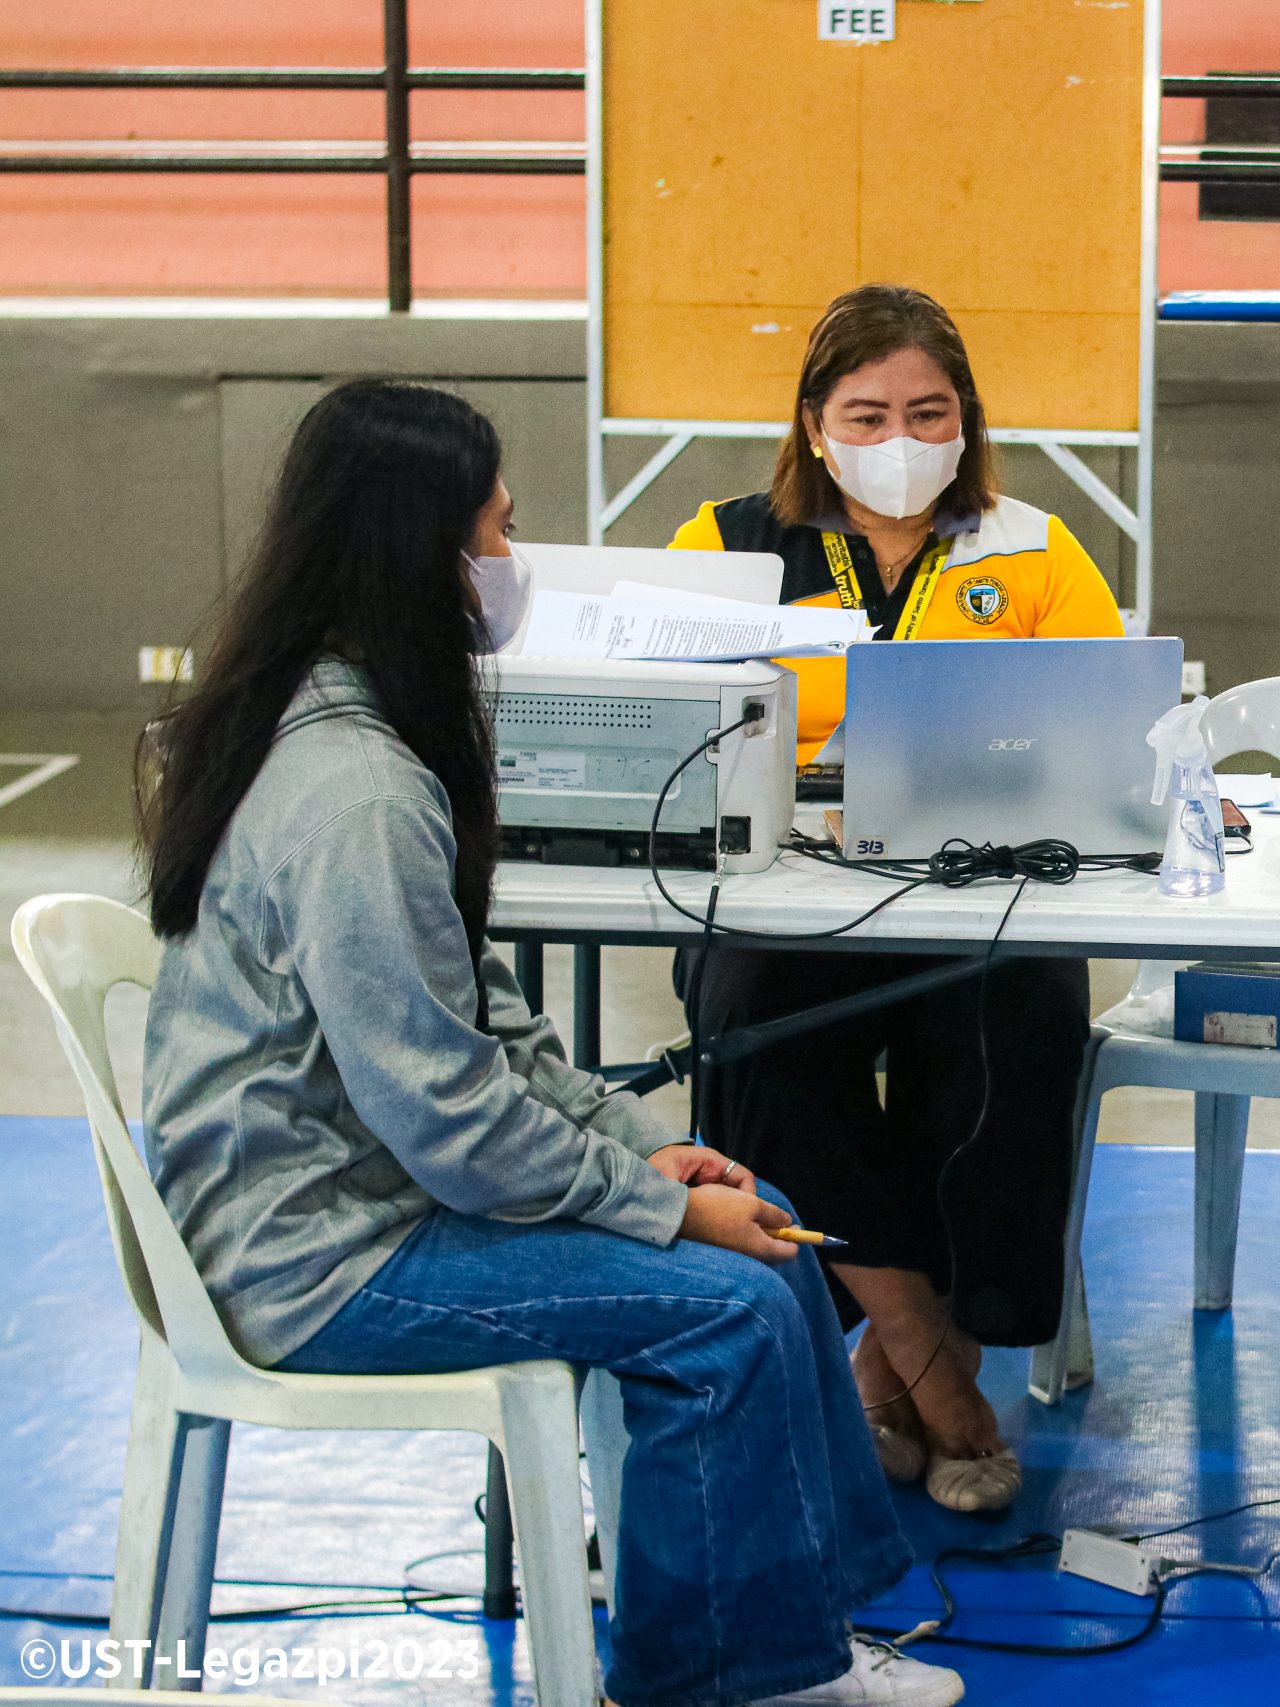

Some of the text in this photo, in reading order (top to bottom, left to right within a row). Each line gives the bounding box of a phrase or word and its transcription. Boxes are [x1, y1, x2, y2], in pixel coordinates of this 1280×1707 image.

[830, 9, 885, 33] FEE
[835, 575, 855, 607] truth
[912, 597, 924, 615] Santo
[988, 737, 1038, 752] acer
[856, 839, 885, 855] 313
